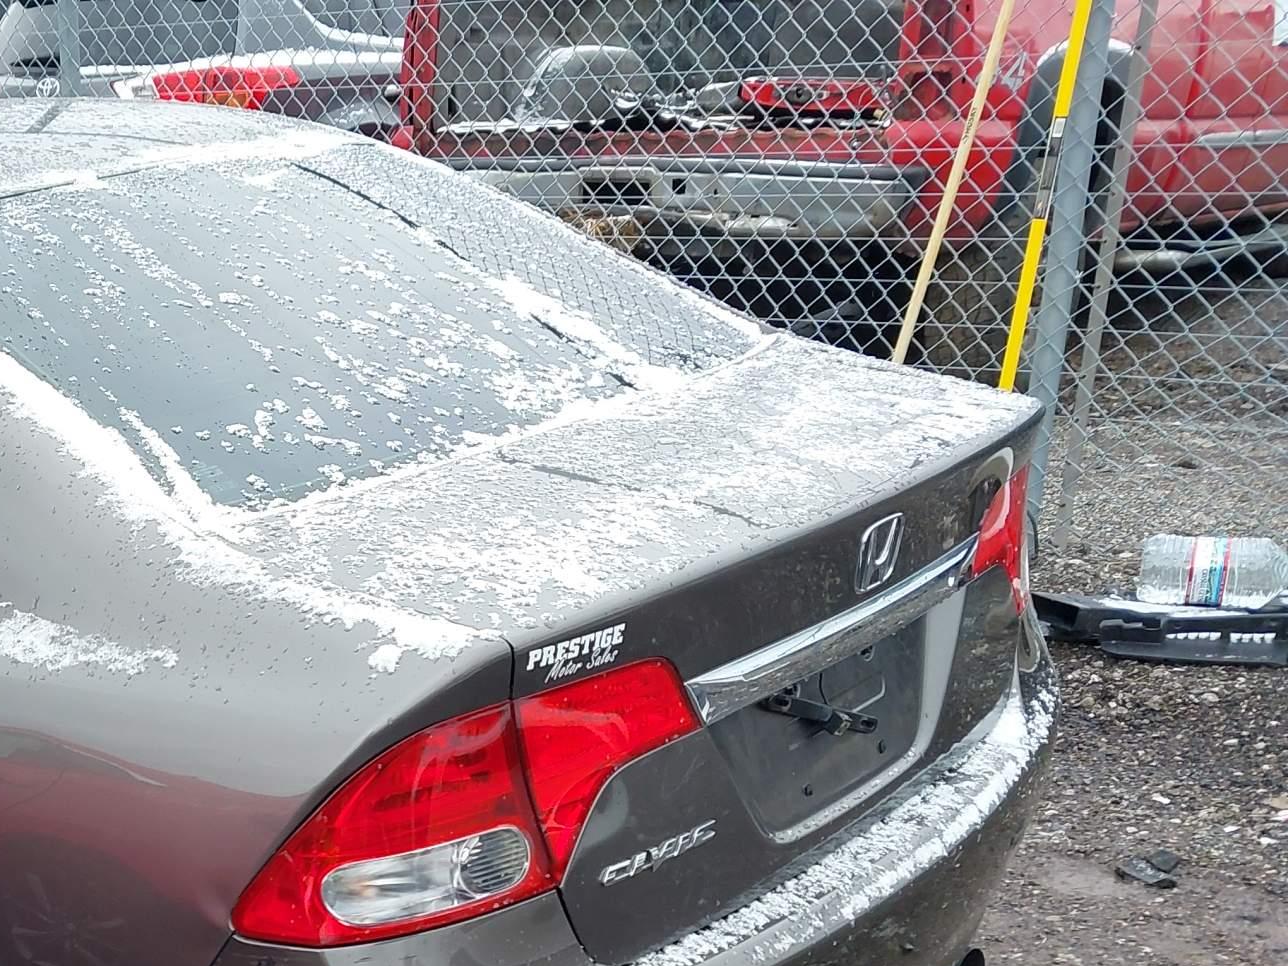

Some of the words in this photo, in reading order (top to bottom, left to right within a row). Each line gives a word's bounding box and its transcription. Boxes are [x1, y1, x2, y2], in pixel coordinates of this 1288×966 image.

[526, 623, 626, 671] PRESTIGE
[544, 658, 583, 684] Motor
[586, 645, 619, 670] Sales
